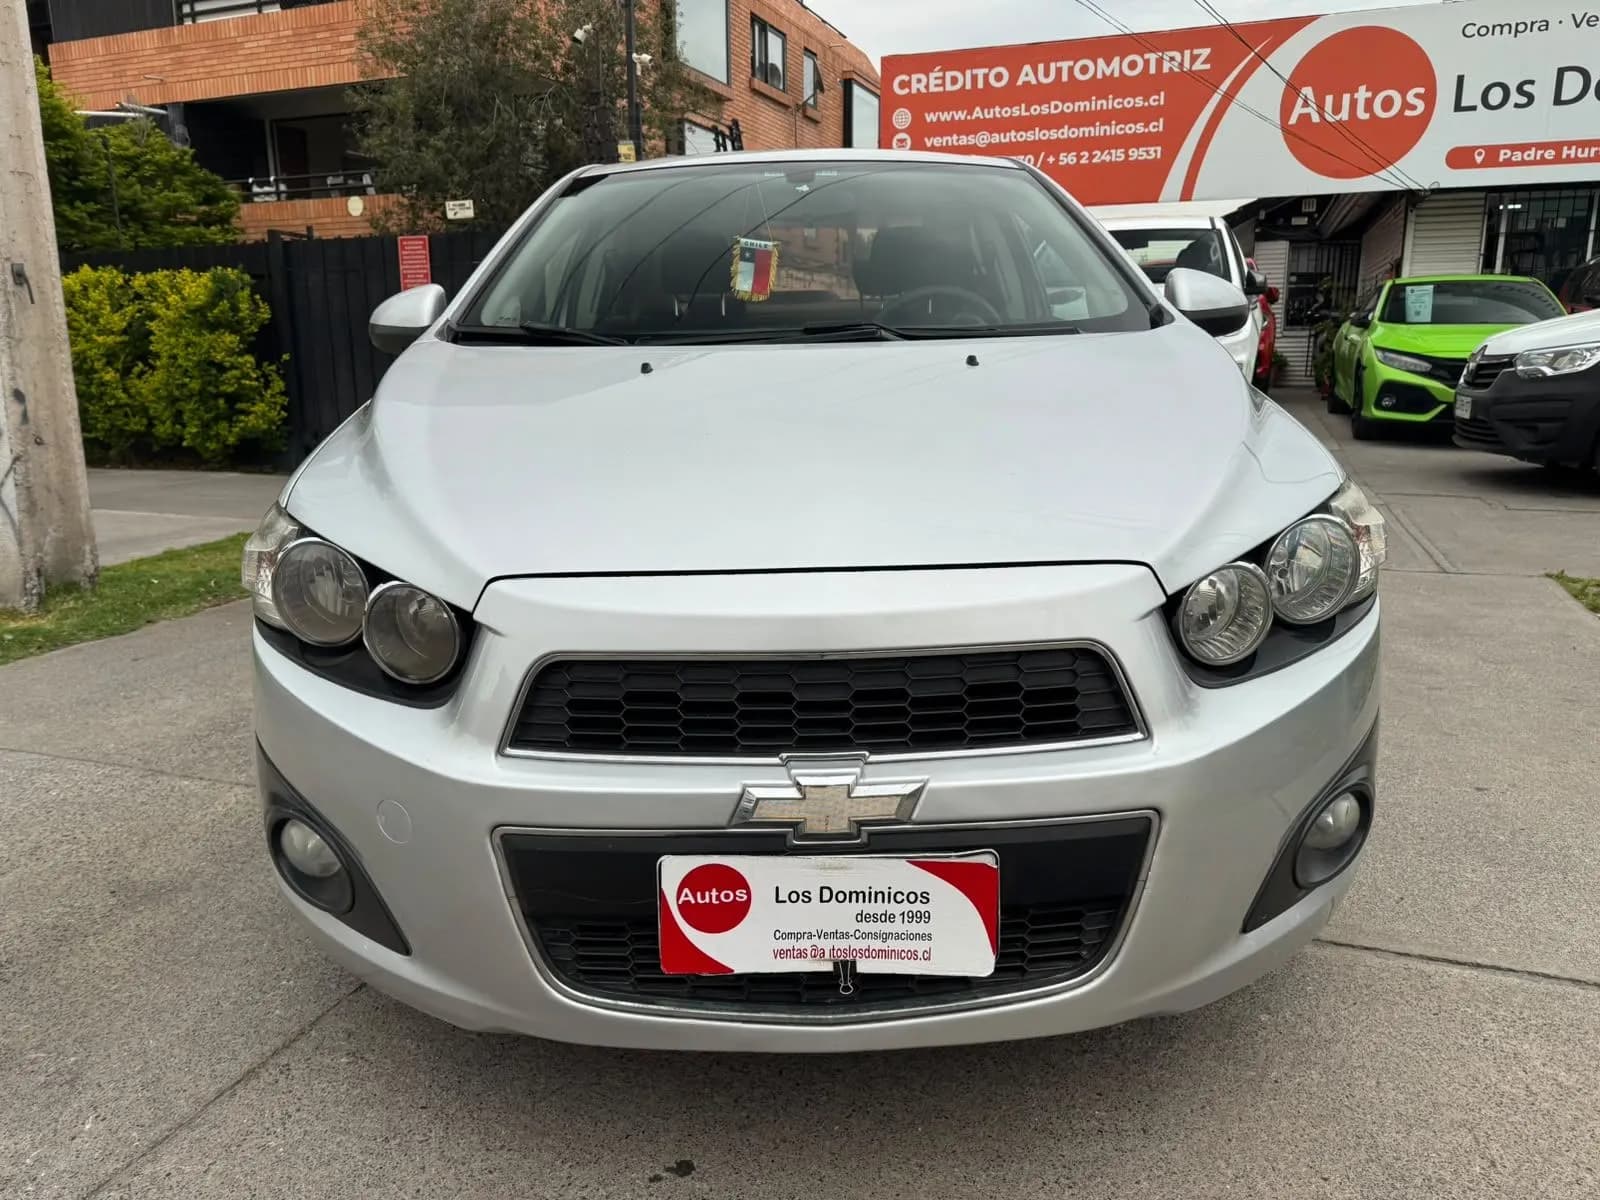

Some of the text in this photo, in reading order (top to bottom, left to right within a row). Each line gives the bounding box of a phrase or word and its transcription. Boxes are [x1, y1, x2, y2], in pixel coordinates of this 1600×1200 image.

[1462, 17, 1550, 39] Compra
[892, 48, 1212, 96] CRÉDITO AUTOMOTRIZ
[1453, 65, 1600, 113] Los D
[924, 92, 1165, 123] www.AutosLosDominicos.cl
[1288, 84, 1427, 126] Autos
[924, 119, 1164, 148] ventas@autoslosdominicos.cl
[1058, 150, 1077, 166] 56
[1079, 149, 1089, 164] 2
[1091, 148, 1126, 163] 2415
[1127, 146, 1162, 161] 9531
[1499, 145, 1600, 163] Padre Hur
[678, 888, 748, 905] Autos
[775, 886, 931, 905] Los Dominicos
[855, 909, 931, 925] desde 1999
[773, 929, 933, 943] Compra-Ventas-Consignaciones
